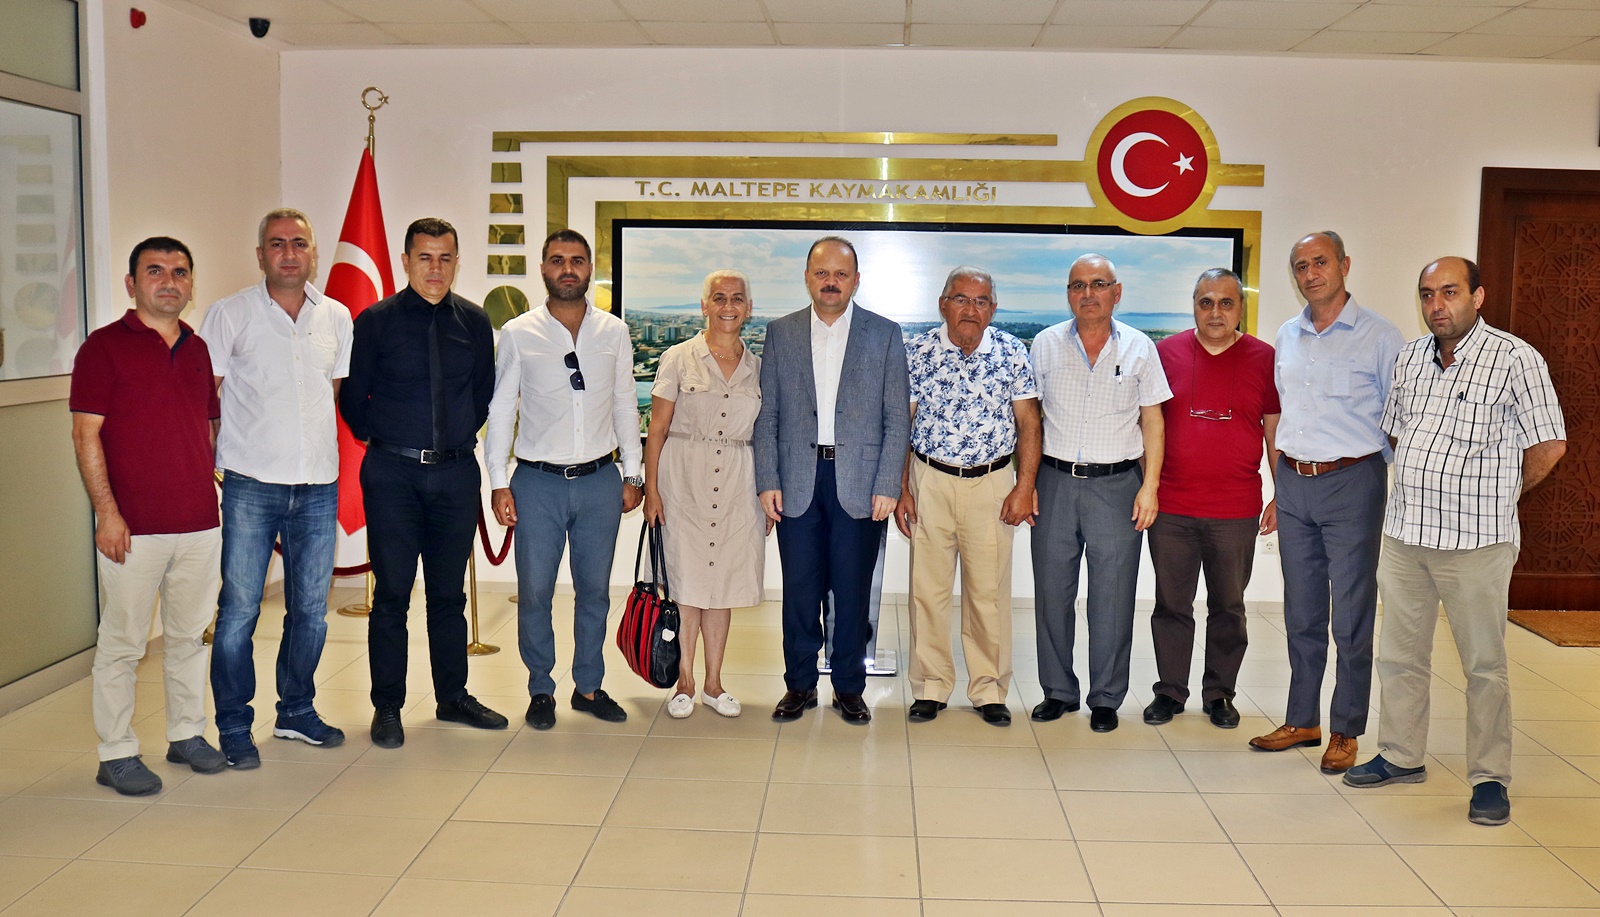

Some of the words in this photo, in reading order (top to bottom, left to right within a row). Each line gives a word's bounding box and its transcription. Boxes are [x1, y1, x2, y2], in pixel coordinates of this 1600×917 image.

[635, 180, 680, 196] T.C.
[690, 181, 799, 197] MALTEPE
[809, 182, 997, 201] KAYMAKAMLIĞI
